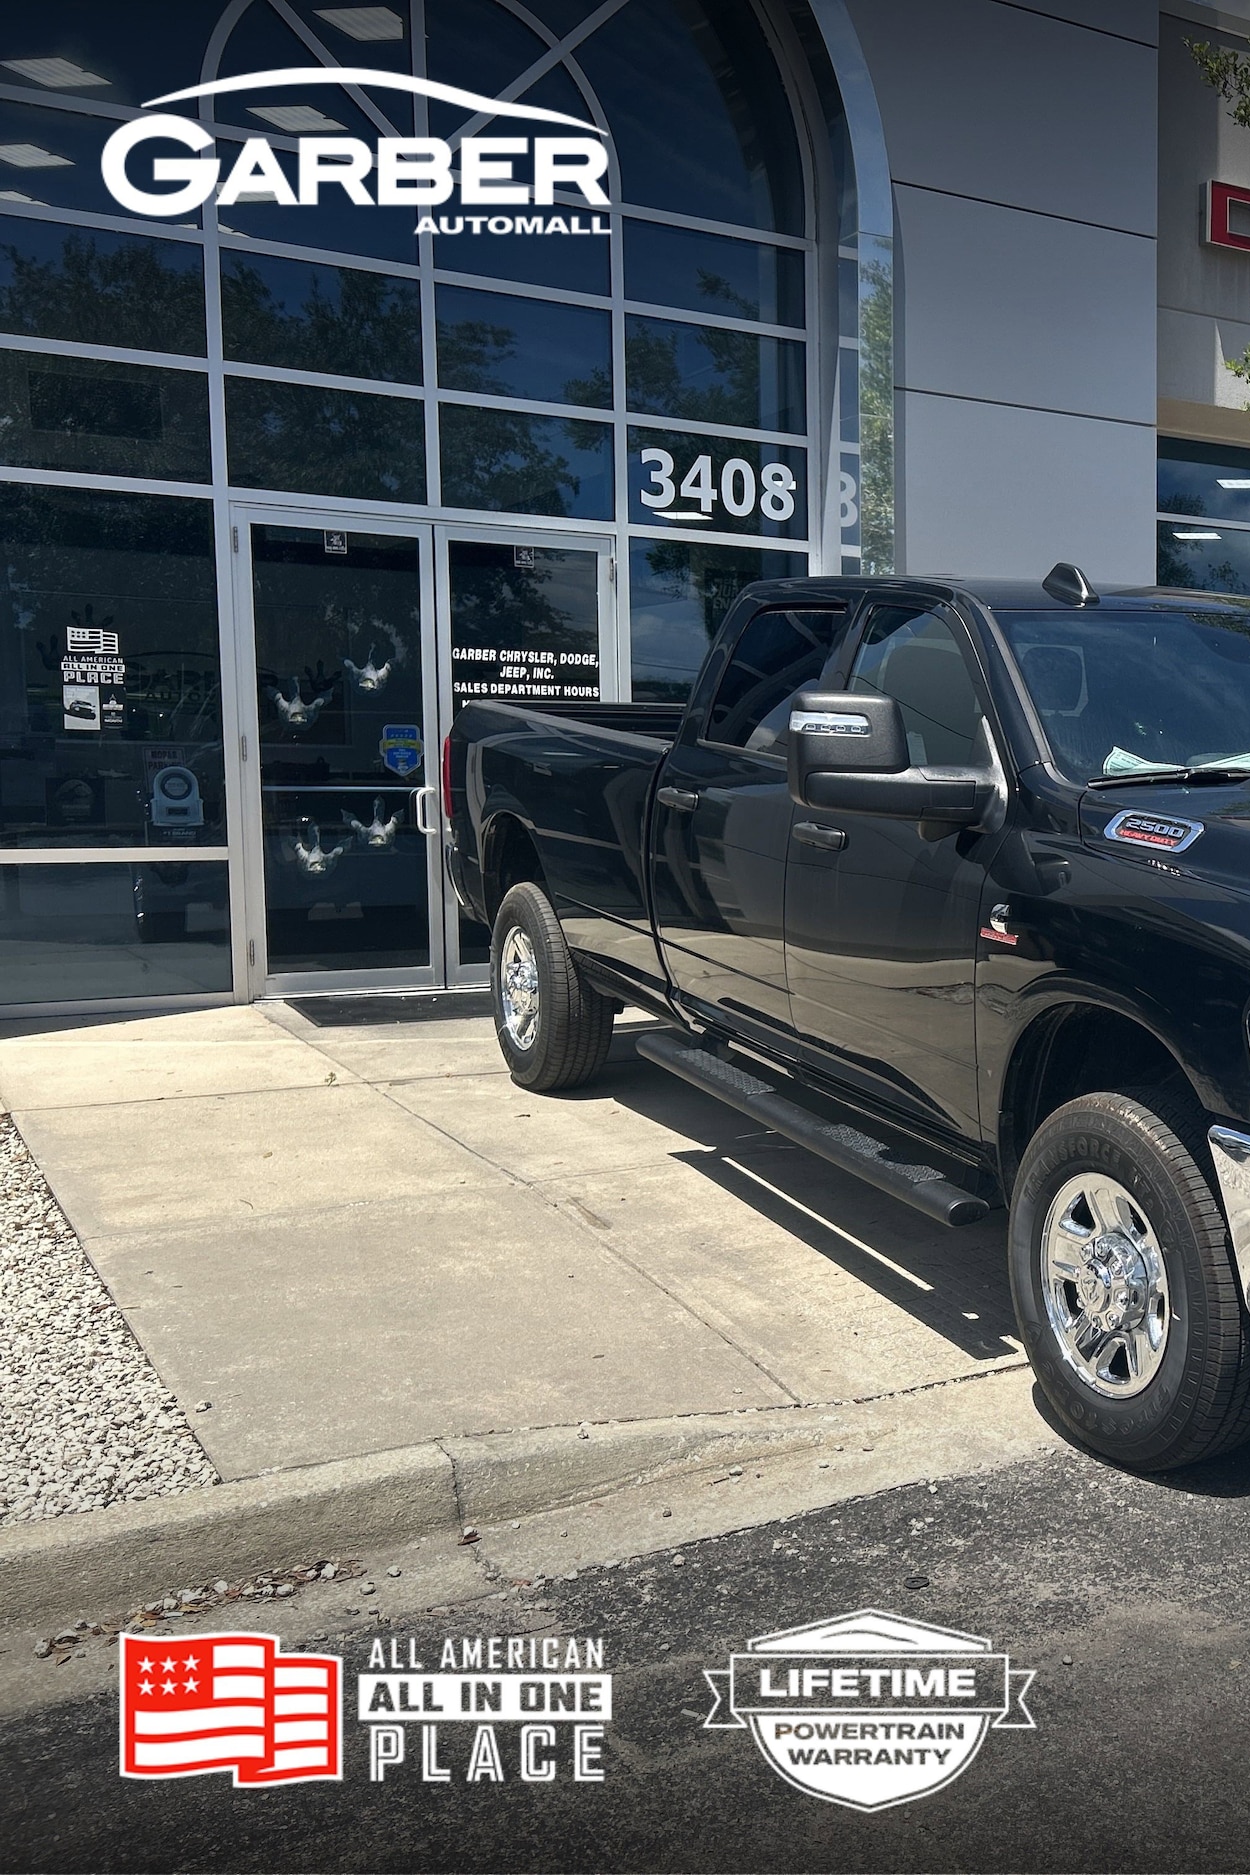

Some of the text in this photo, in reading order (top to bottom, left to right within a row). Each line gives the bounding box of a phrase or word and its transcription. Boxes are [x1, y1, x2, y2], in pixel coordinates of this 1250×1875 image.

[640, 448, 796, 521] 3408
[81, 656, 123, 664] AMERICAN
[452, 648, 599, 668] GARBER CHRYSLER, DODGE,
[63, 671, 124, 684] PLACE
[500, 666, 554, 680] JEEP, INC.
[454, 682, 599, 697] SALES DEPARTMENT HOURS
[1125, 818, 1185, 838] 2500
[1119, 829, 1150, 842] HEAVY
